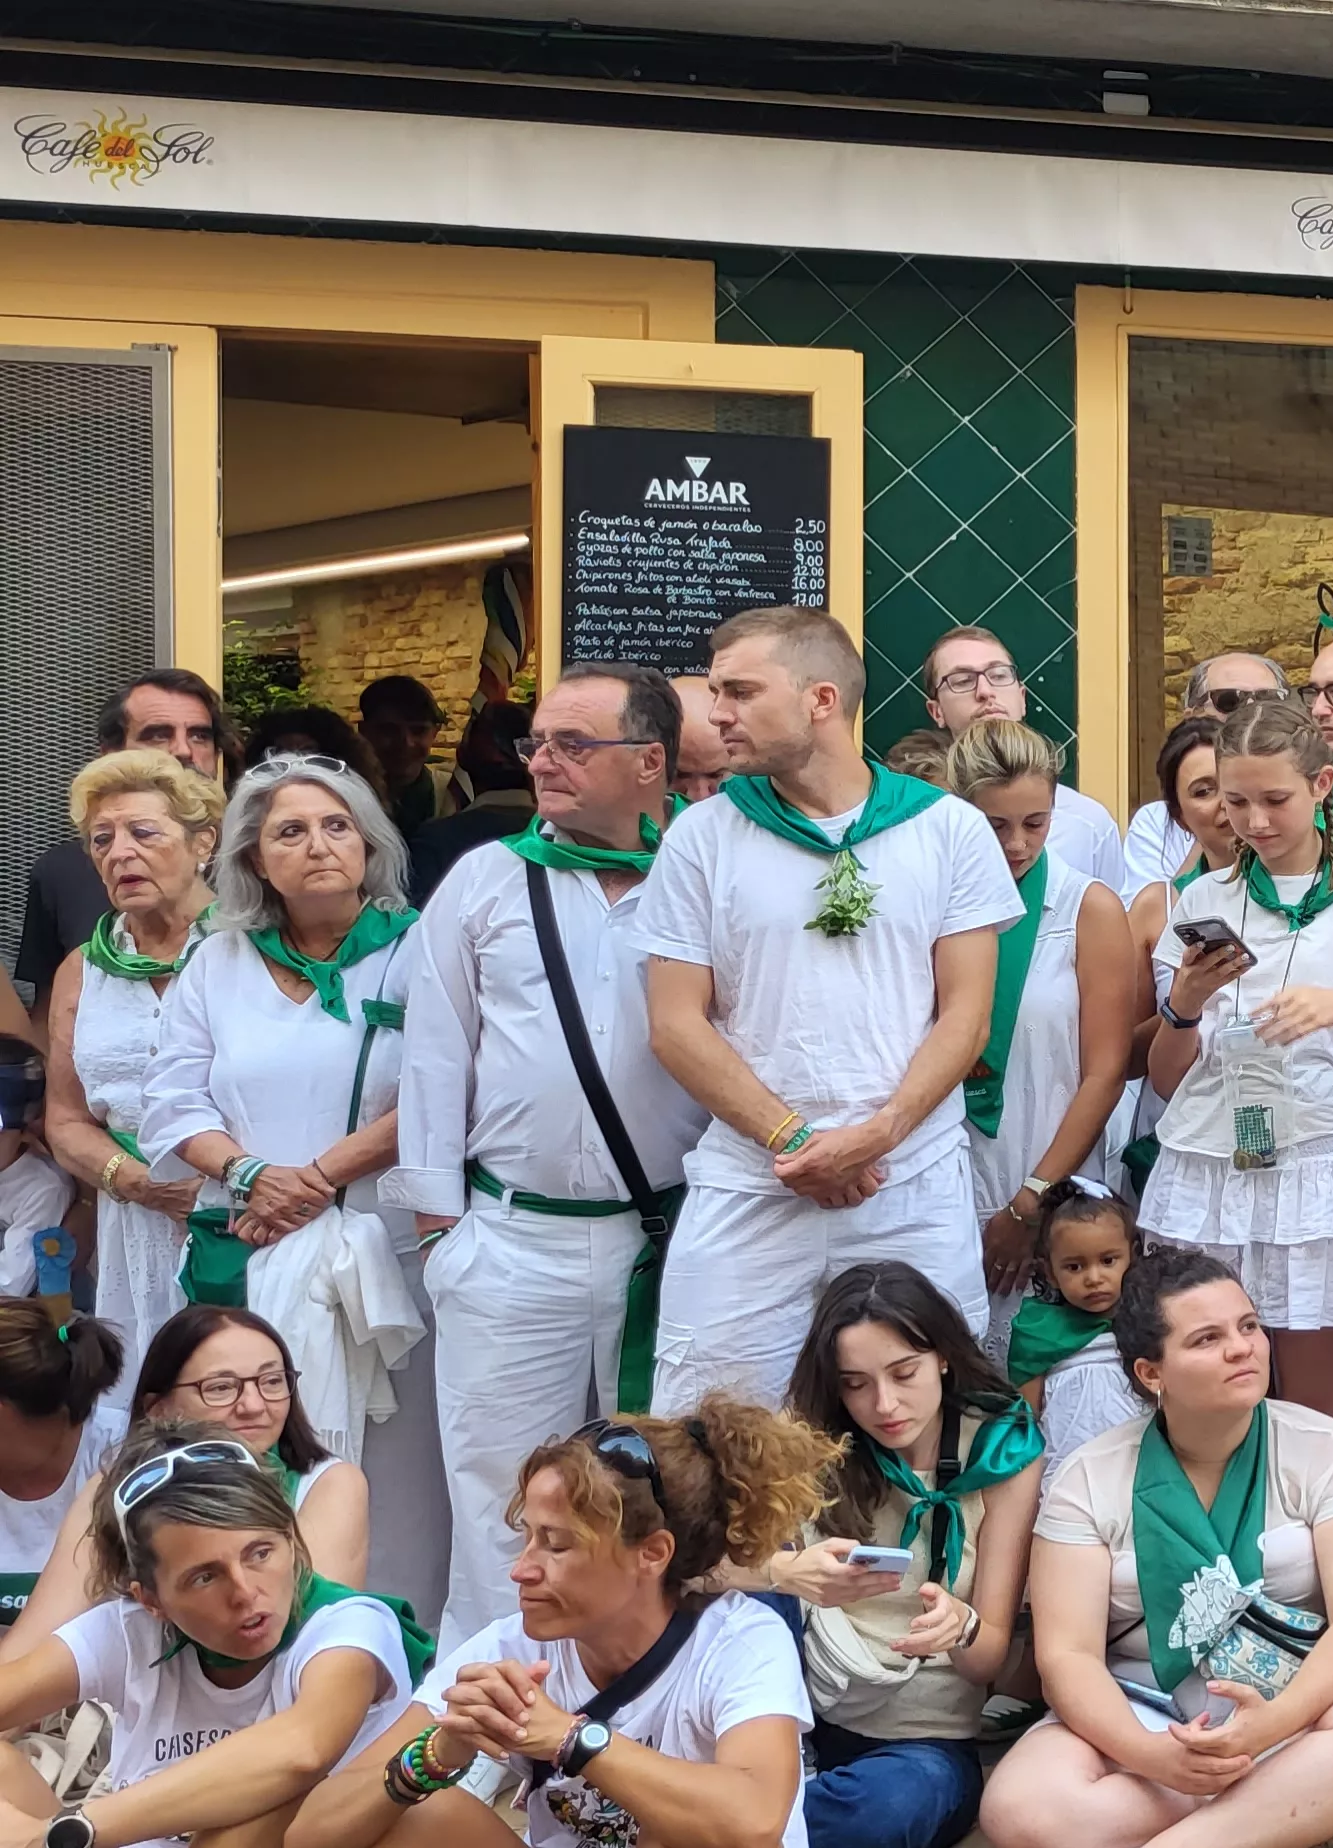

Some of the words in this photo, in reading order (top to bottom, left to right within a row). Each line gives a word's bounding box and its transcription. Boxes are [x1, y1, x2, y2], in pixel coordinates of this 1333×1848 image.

[105, 137, 135, 158] del
[139, 123, 214, 179] Sol
[82, 160, 147, 170] HUESCA
[644, 477, 751, 505] AMBAR
[643, 502, 690, 510] CERVECEROS
[691, 505, 752, 513] INDEPENDIENTES
[578, 510, 641, 530] Croquetas
[643, 517, 656, 528] de
[658, 519, 698, 532] jamón
[712, 519, 763, 533] bacalao
[577, 527, 647, 544] Ensaladilla
[650, 532, 682, 545] Rusa
[577, 541, 619, 556] Gyozas
[621, 543, 632, 554] de
[633, 545, 665, 557] pollo
[667, 548, 686, 557] con
[688, 549, 717, 560] salsa
[719, 552, 767, 564] japonesa
[795, 553, 824, 567] 9.00
[575, 555, 622, 567] Raviolis
[626, 559, 680, 572] crujientes
[683, 560, 694, 570] de
[793, 564, 825, 577] 12.00
[575, 569, 633, 582] Chipirones
[635, 571, 665, 583] fritos
[665, 575, 684, 583] con
[791, 576, 826, 590] 16.00
[574, 581, 619, 594] Tomate
[623, 583, 651, 595] Rosa
[653, 584, 663, 595] de
[714, 589, 732, 597] con
[792, 592, 824, 608] 17.00
[666, 595, 677, 604] de
[682, 596, 717, 606] Bonito
[612, 607, 629, 616] con
[574, 618, 633, 634] Alcachofas
[633, 620, 665, 635] fritas
[667, 625, 682, 633] con
[573, 635, 601, 646] Plato
[603, 635, 615, 646] de
[618, 637, 652, 649] jamón
[571, 647, 614, 660] Surtido
[663, 666, 680, 674] con
